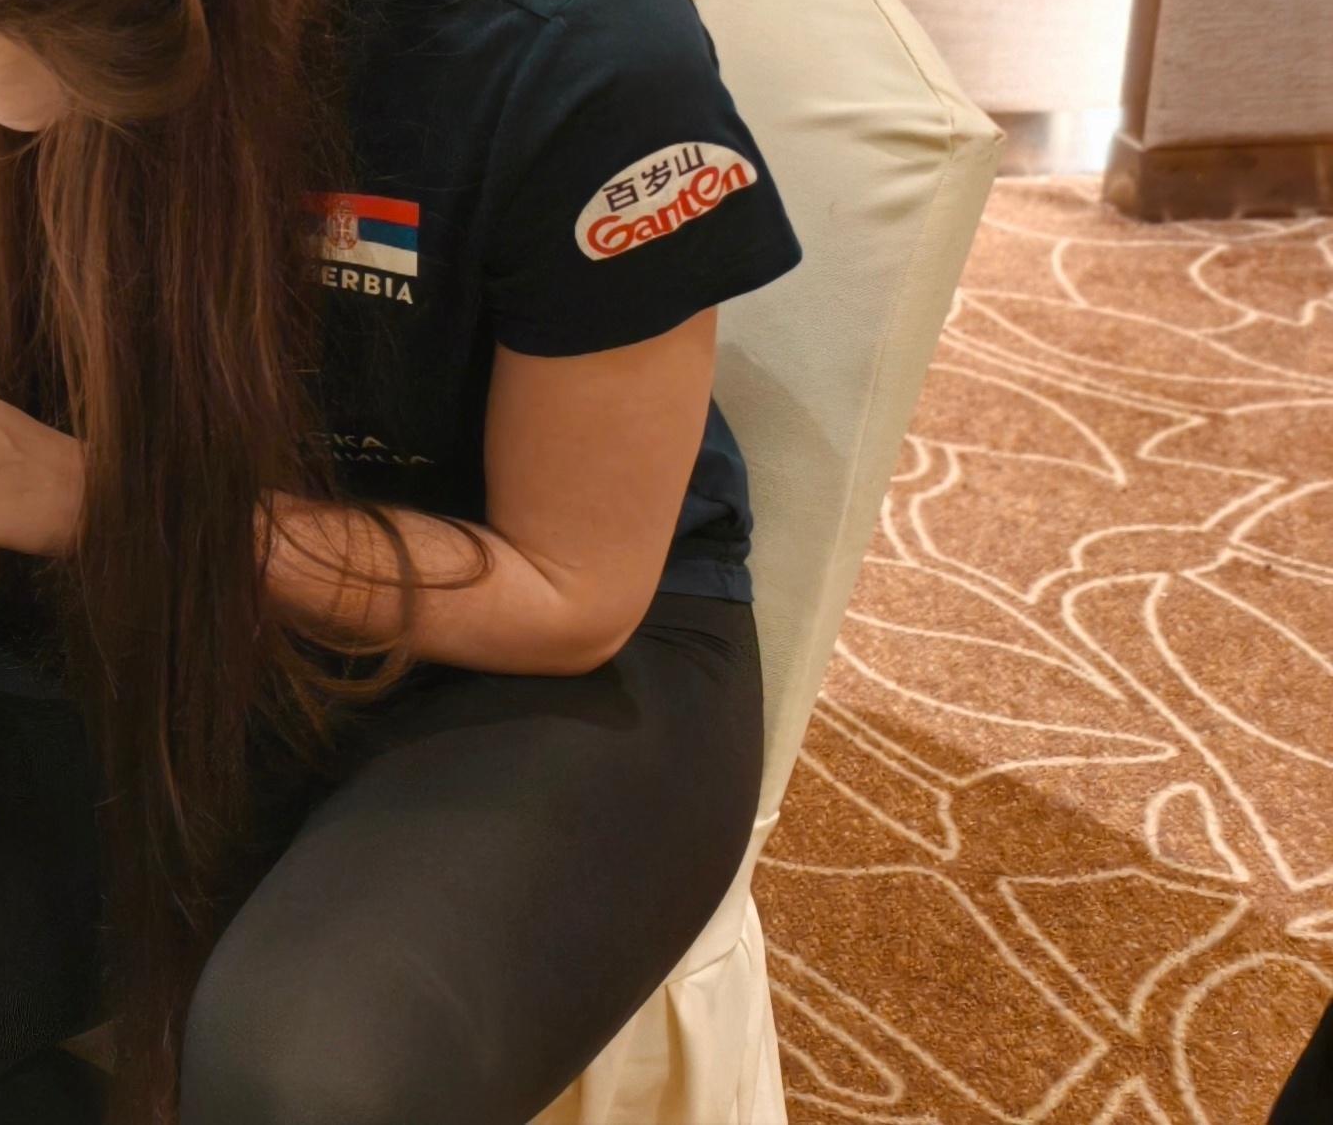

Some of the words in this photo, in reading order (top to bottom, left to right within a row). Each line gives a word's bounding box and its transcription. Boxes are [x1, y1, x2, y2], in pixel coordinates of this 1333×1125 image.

[603, 145, 705, 212] 百岁山
[321, 266, 413, 305] ERBIA
